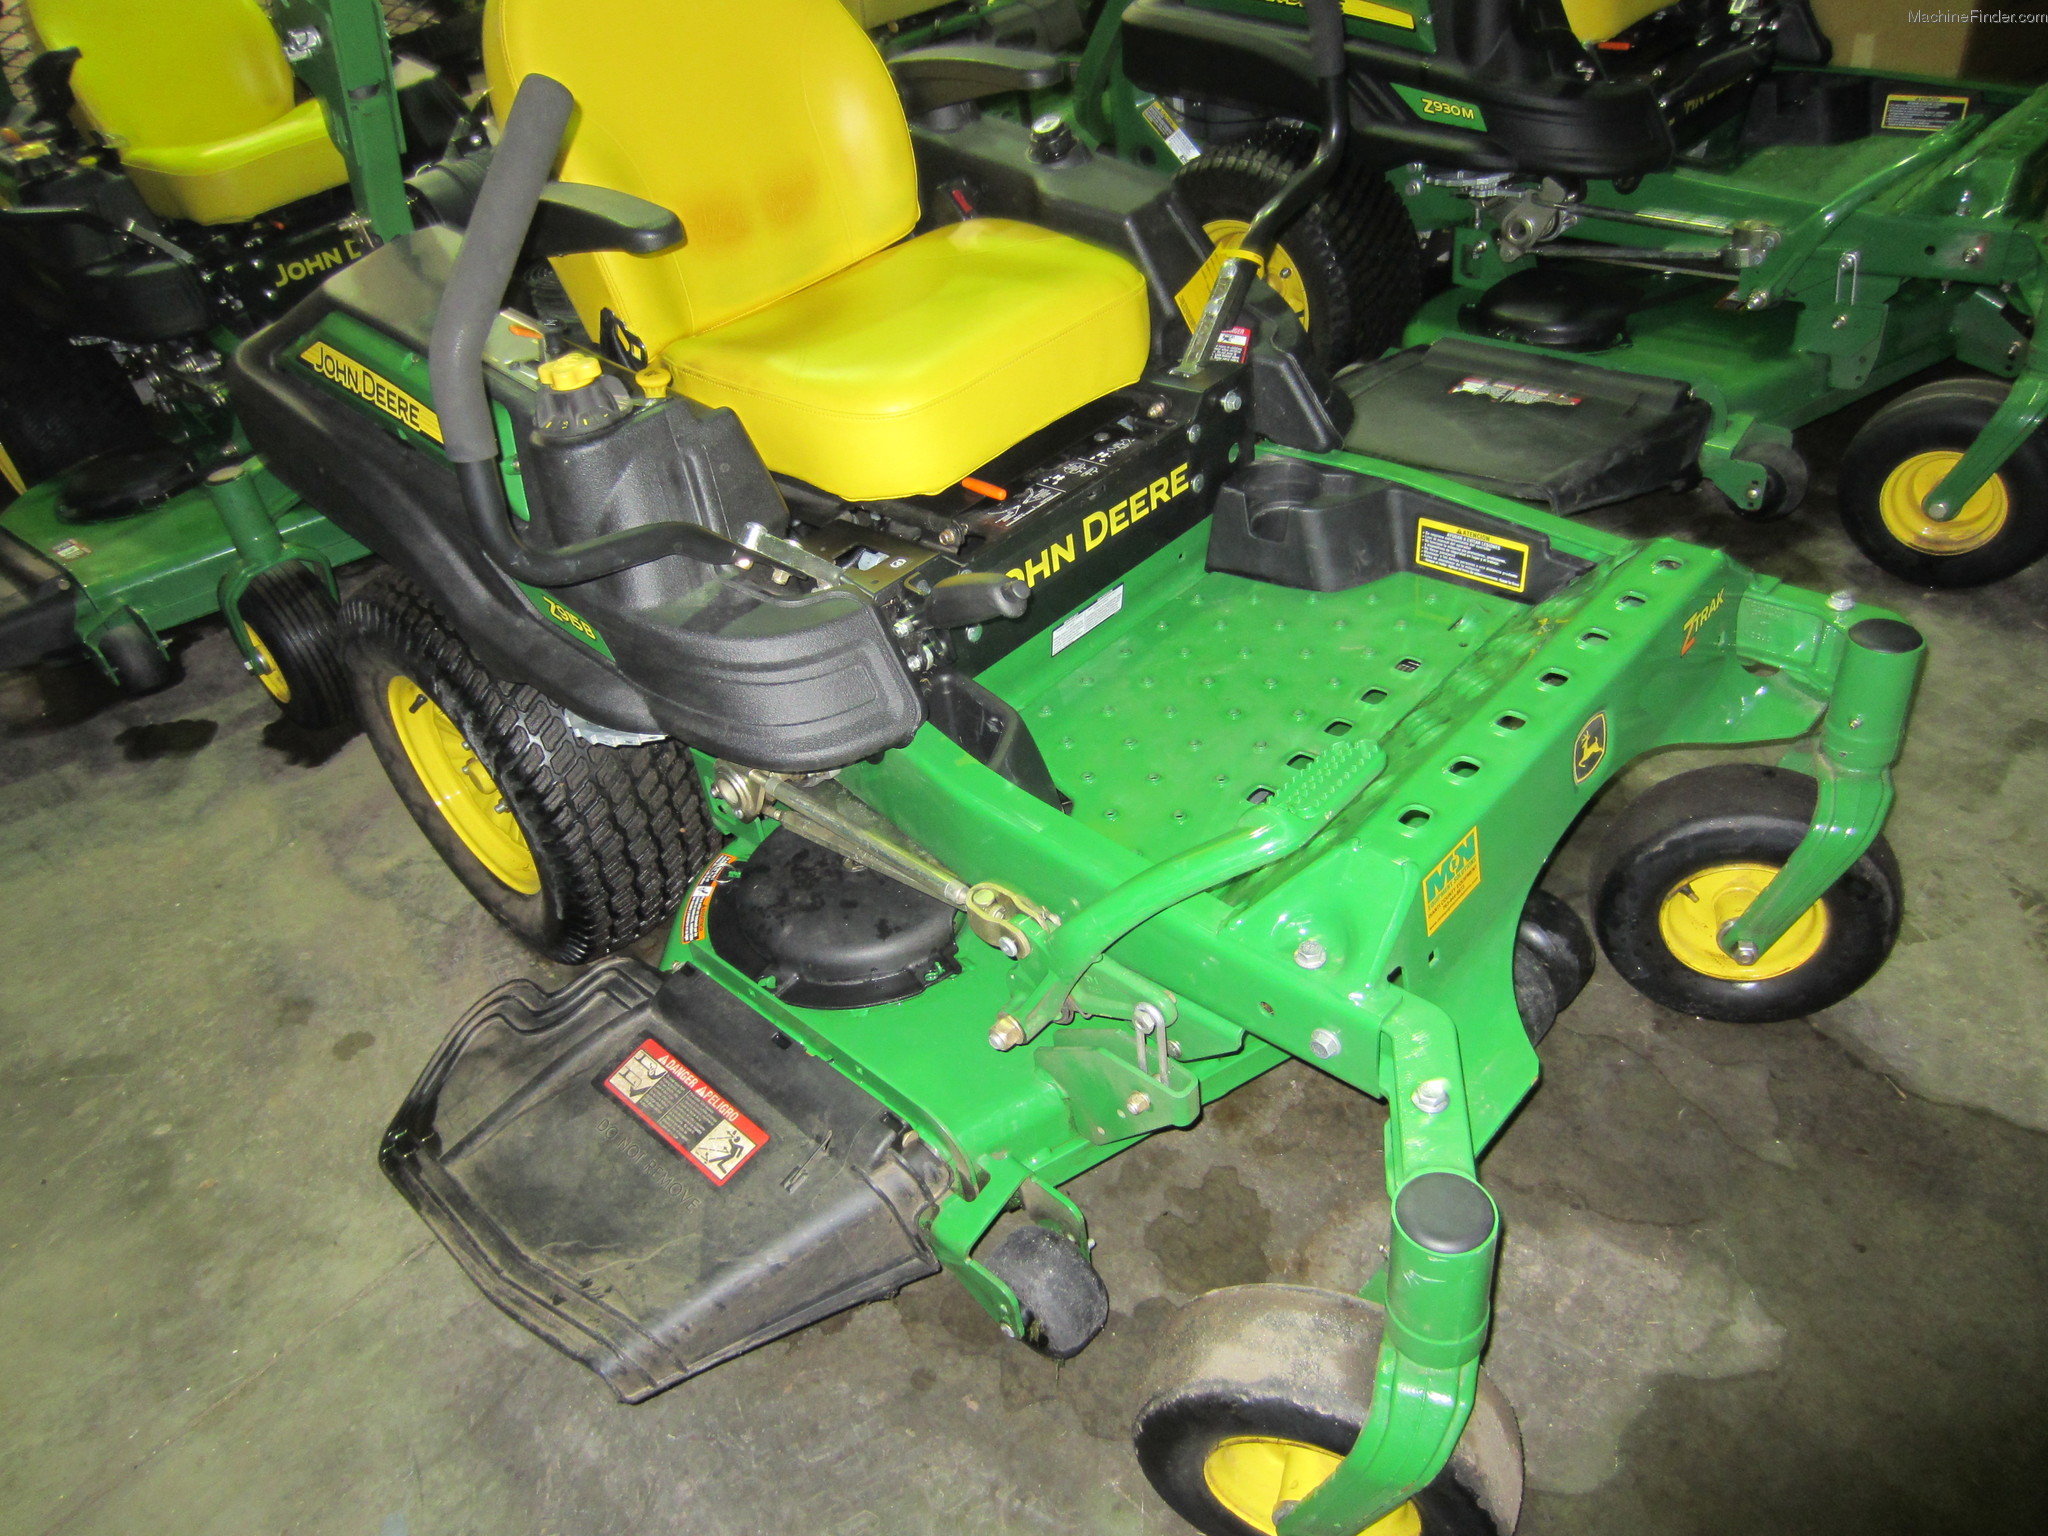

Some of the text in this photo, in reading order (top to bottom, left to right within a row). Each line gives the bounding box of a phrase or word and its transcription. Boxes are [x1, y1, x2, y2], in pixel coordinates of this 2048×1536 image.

[1421, 98, 1475, 119] Z930M
[275, 247, 344, 288] JOHN
[313, 347, 420, 429] JOHN DEERE
[1005, 462, 1190, 588] HN DEERE
[665, 1058, 699, 1088] DANGER
[703, 1089, 741, 1122] PELIGRO
[596, 1118, 702, 1215] DO NOT REMOVE
